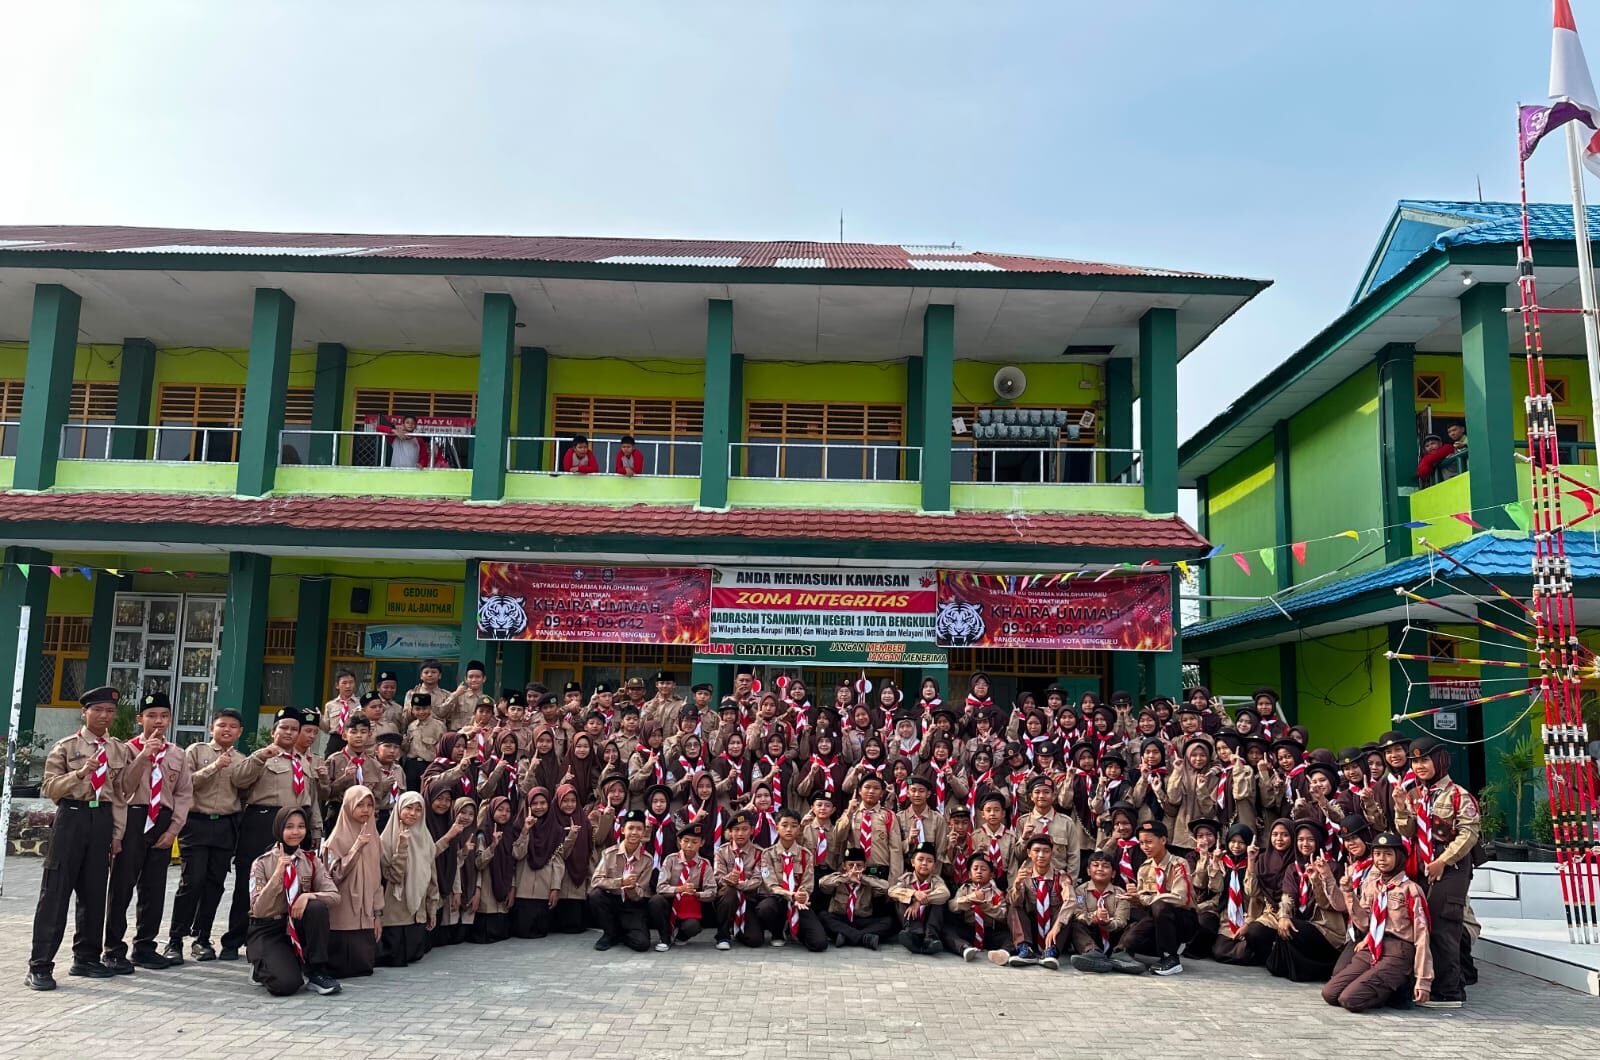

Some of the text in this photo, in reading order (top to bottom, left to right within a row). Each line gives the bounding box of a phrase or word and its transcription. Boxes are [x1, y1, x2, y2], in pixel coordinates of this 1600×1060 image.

[391, 418, 453, 426] DIAHAYU
[736, 571, 910, 587] ANDA MEMASUKI KAWASAN
[403, 587, 439, 598] GEDUNG
[735, 591, 909, 607] ZONA INTEGRITAS
[388, 602, 452, 614] IBNU AL-BAITHAR
[533, 598, 661, 614] KHAIRA UMMAH
[991, 605, 1121, 620] KHAIRA UMMAH
[544, 615, 645, 630] 09.041-09.042
[710, 612, 936, 628] MADRASAH TSANAWIYAH NEGERI 1 KOTA BENGKULU
[718, 625, 741, 635] Wilayah
[742, 626, 760, 634] Bebas
[761, 627, 783, 637] Korupsi
[803, 627, 814, 635] dan
[816, 627, 838, 638] Wilayah
[886, 629, 897, 637] dan
[898, 629, 924, 639] Melayani
[1001, 622, 1105, 636] 09.041-09.042
[994, 636, 1034, 644] PANGKALAN
[694, 643, 817, 657] TOLAK GRATIFIKASI
[829, 642, 906, 653] JANGAN MEMBERI
[867, 652, 947, 663] JANGAN MENERIMA
